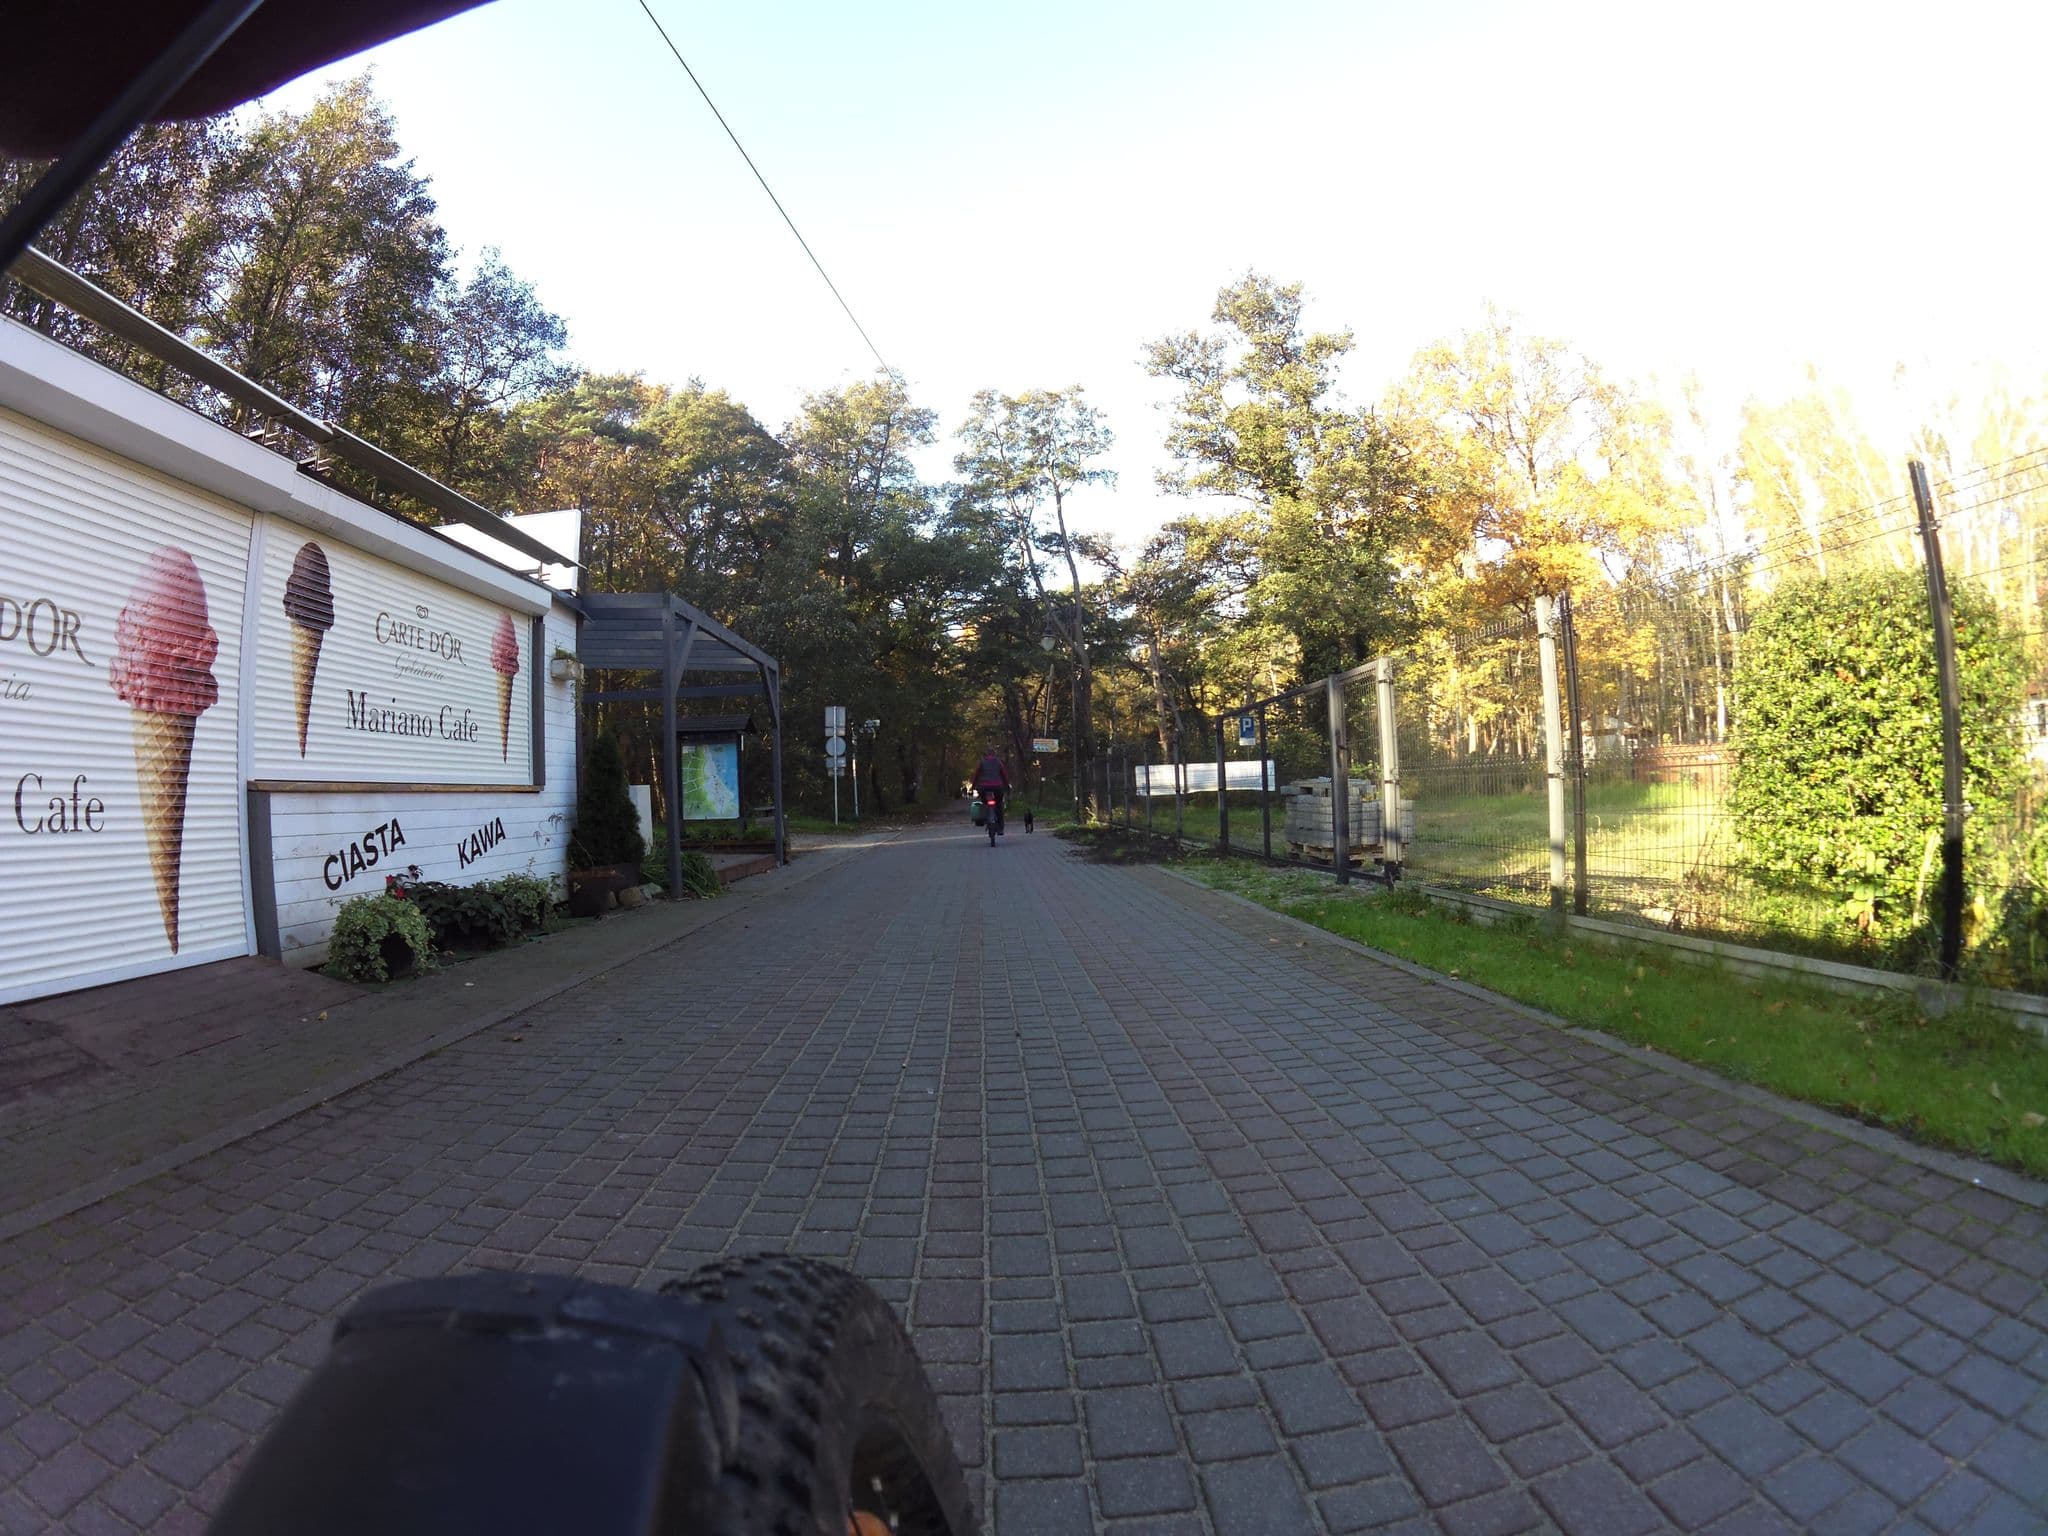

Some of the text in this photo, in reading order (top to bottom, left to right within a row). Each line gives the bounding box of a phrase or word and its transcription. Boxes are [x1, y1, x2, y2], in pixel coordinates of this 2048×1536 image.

[375, 611, 467, 666] CARTE D'OR
[345, 689, 479, 744] Mariano Cafe
[1242, 718, 1252, 732] P
[14, 772, 105, 835] Cafe
[323, 817, 407, 891] CIASTA
[457, 817, 507, 870] KAWA
